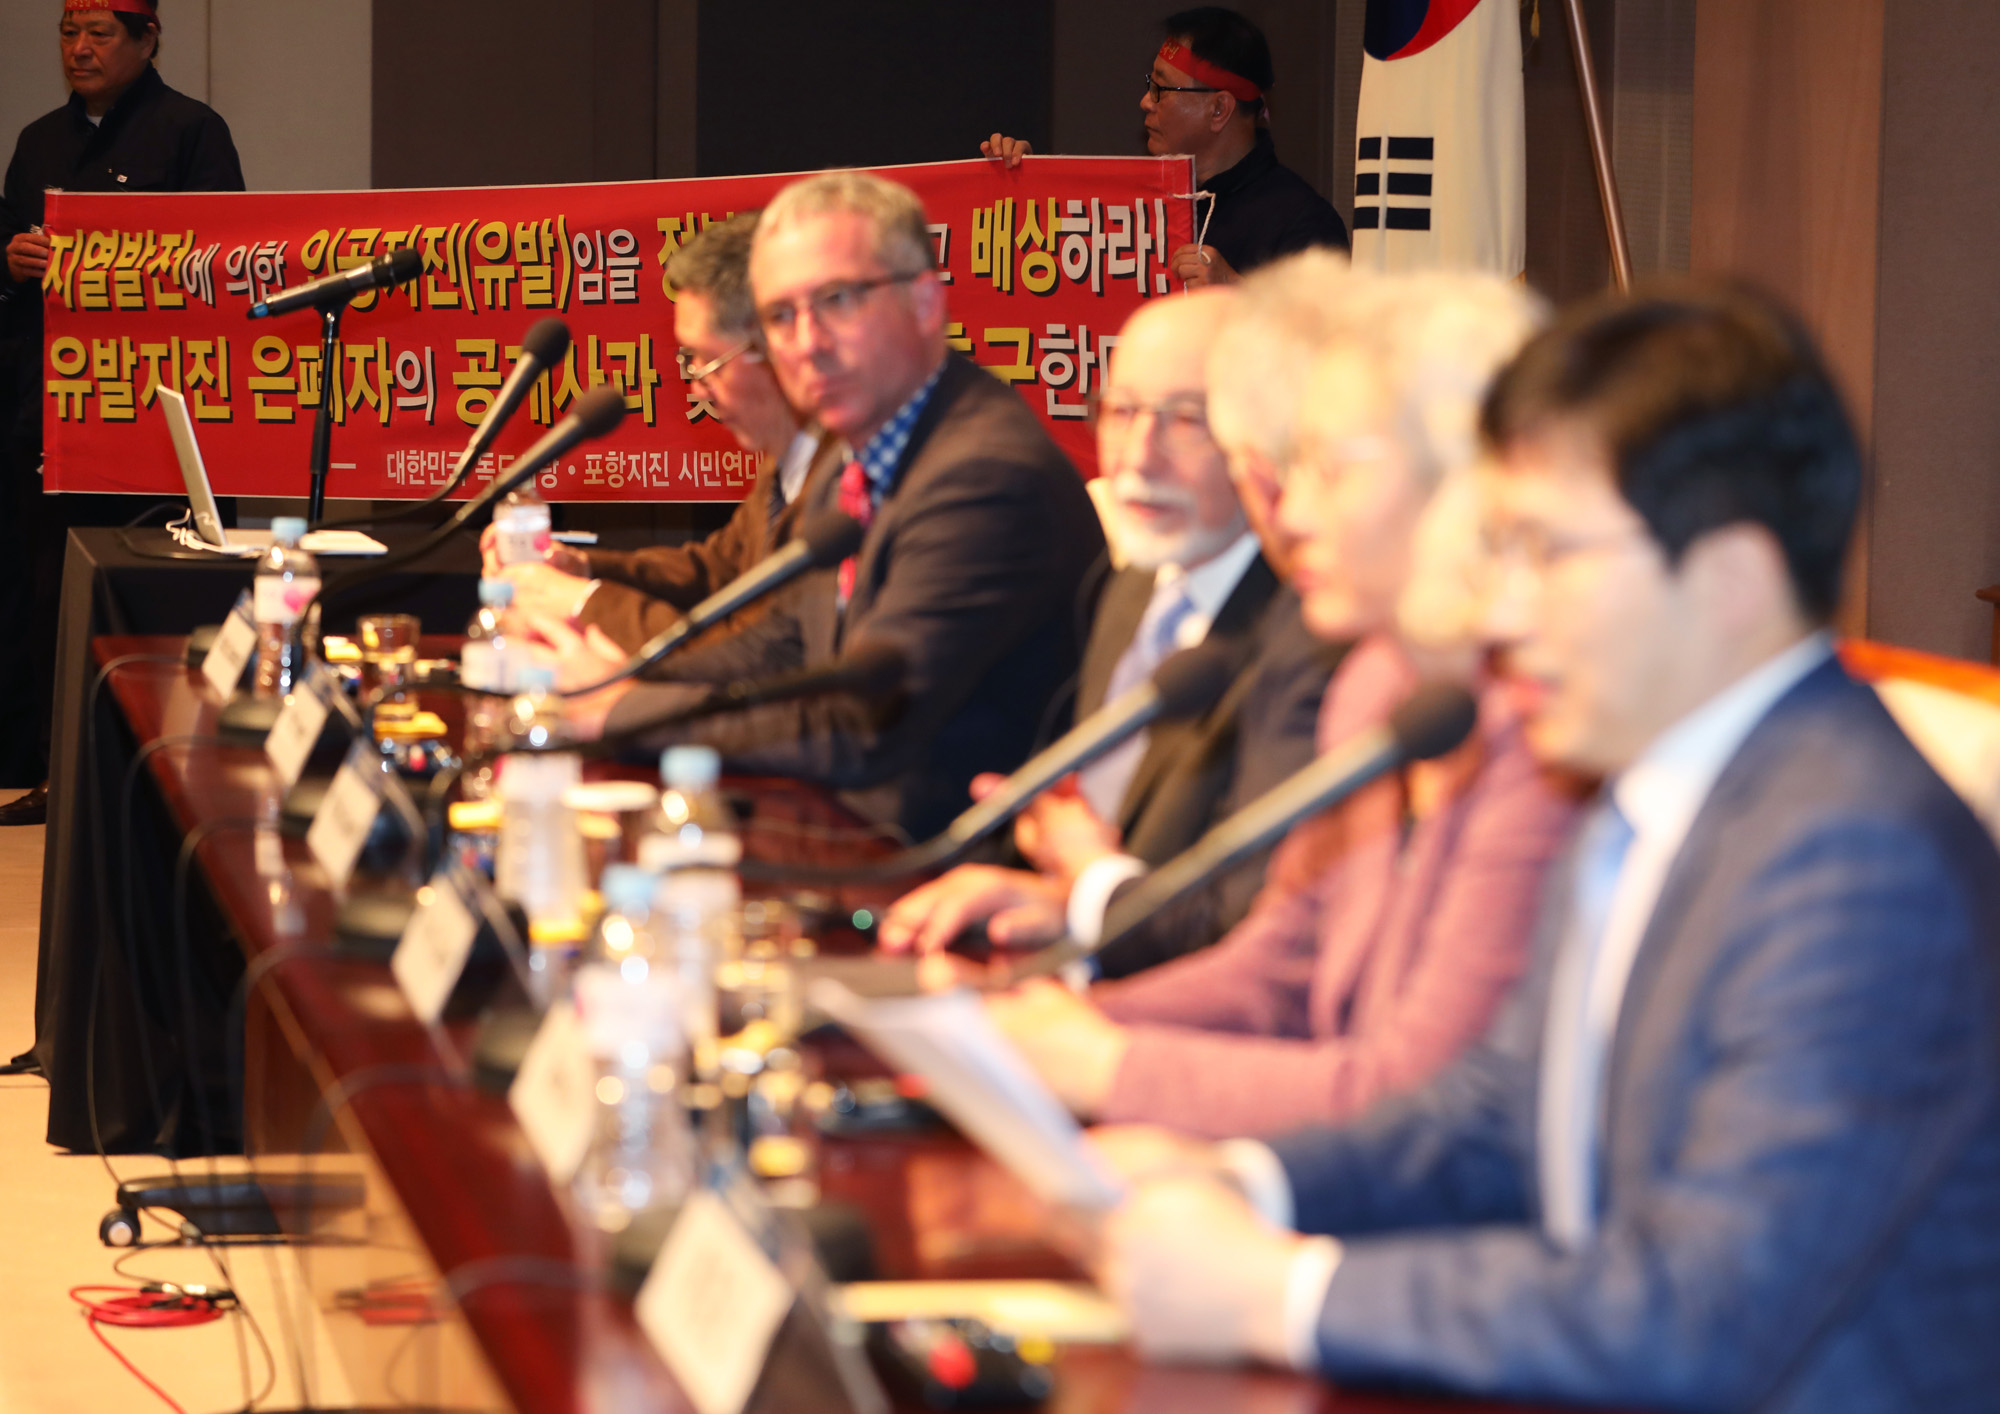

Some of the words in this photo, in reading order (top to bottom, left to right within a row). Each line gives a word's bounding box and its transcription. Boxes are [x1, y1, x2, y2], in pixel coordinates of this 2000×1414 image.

[42, 229, 221, 309] 지열발전에
[225, 240, 288, 304] 의한
[971, 197, 1167, 293] 배상하라!
[47, 336, 231, 420] 유발지진
[248, 335, 435, 424] 은폐자의
[583, 451, 669, 488] 포항지진
